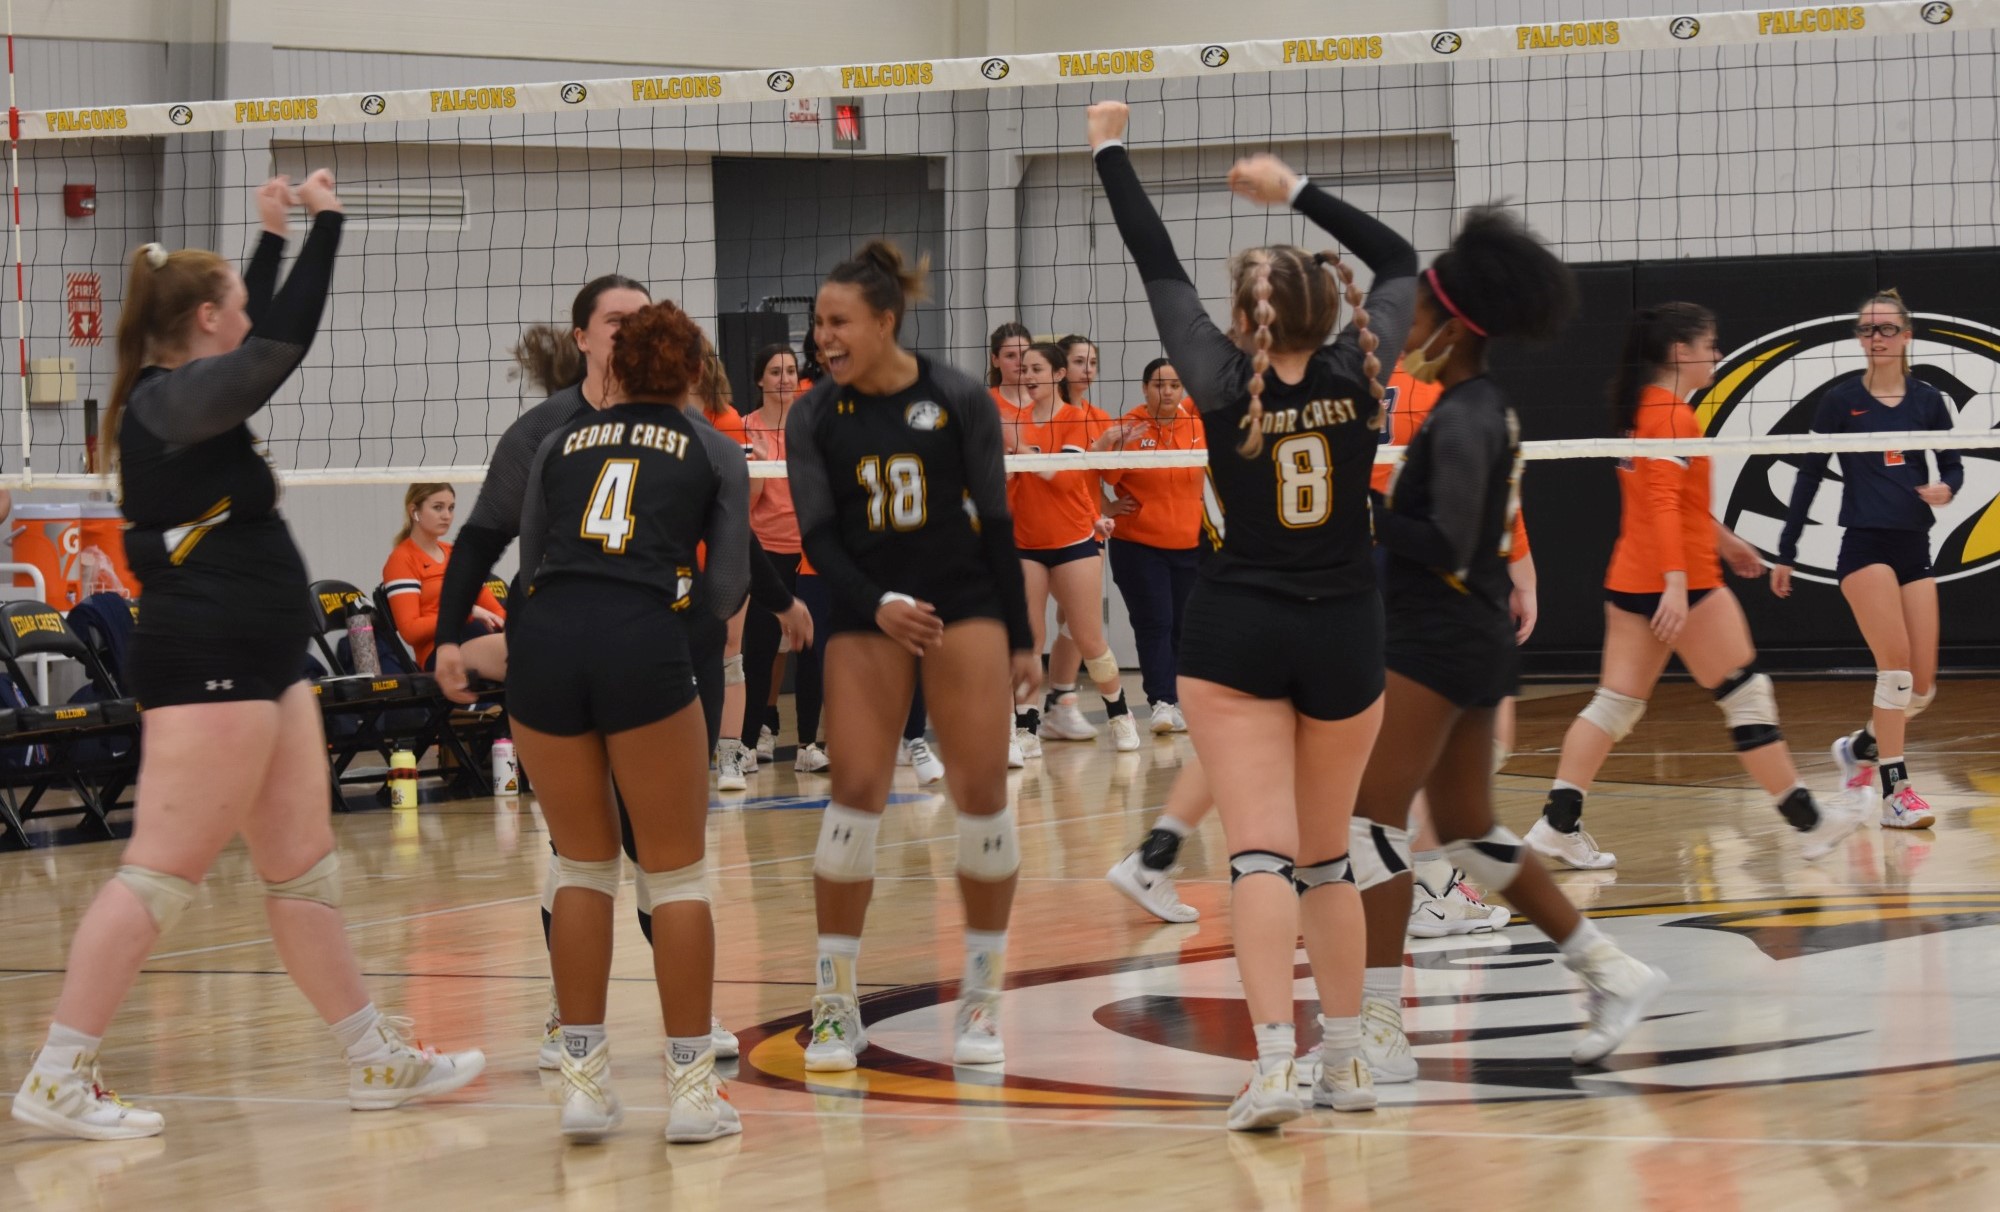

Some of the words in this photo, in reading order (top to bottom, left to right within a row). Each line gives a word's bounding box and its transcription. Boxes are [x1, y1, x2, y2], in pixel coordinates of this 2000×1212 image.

[1758, 6, 1866, 35] FALCONS
[1283, 35, 1383, 64] FALCONS
[1516, 21, 1620, 50] FALCONS
[840, 62, 934, 89] FALCONS
[1058, 49, 1155, 77] FALCONS
[430, 86, 517, 113] FALCONS
[631, 75, 722, 101] FALCONS
[45, 108, 128, 132] FALCONS
[234, 98, 318, 123] FALCONS
[1239, 408, 1299, 434] CDAR
[1301, 399, 1358, 430] CREST
[563, 421, 626, 457] CEDAR
[629, 422, 690, 460] CREST
[856, 453, 927, 532] 18
[1272, 431, 1334, 530] 8
[580, 457, 640, 555] 4
[35, 612, 66, 634] CREST
[54, 707, 87, 720] FALCONS
